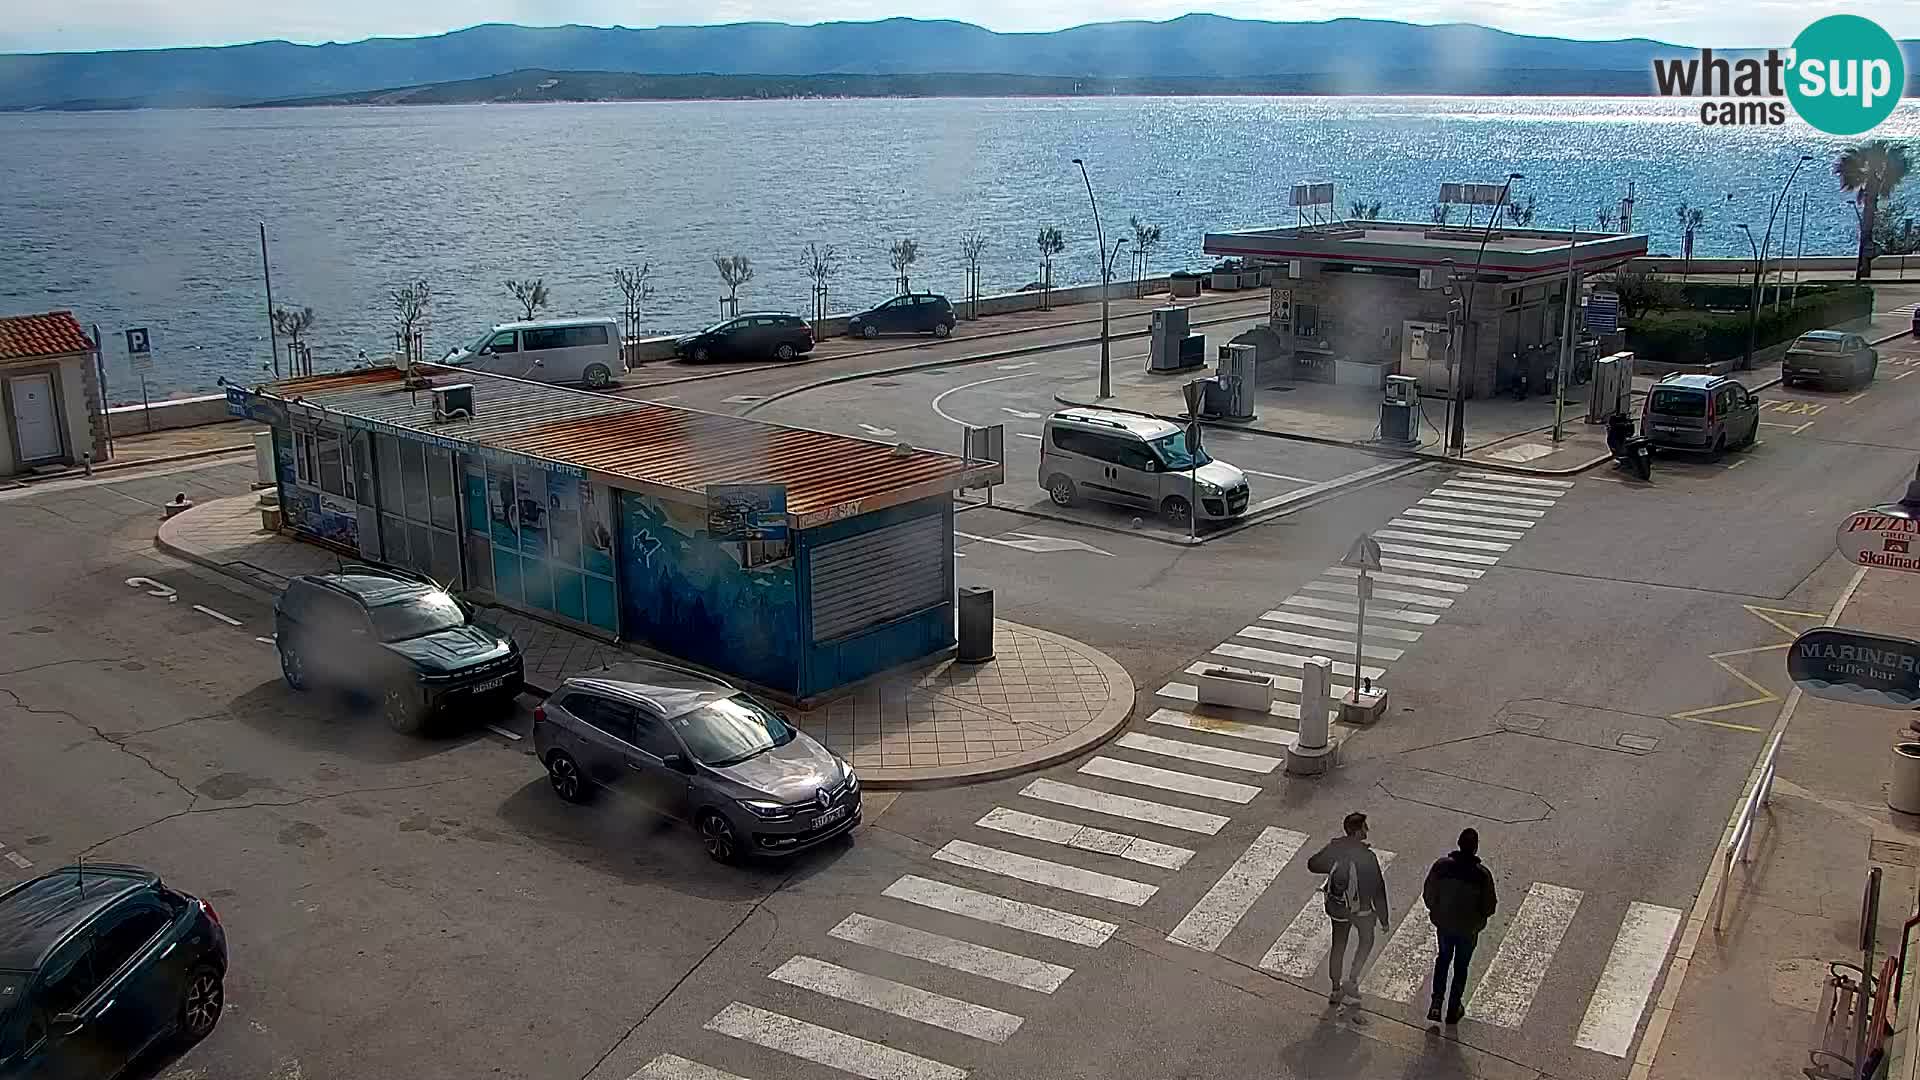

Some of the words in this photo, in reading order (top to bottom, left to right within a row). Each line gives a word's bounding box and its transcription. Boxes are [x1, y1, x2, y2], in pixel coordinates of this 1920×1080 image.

[131, 332, 144, 350] P
[1758, 400, 1827, 415] TAXI
[556, 463, 582, 478] OFFICE
[1847, 516, 1920, 535] PIZZE
[1799, 643, 1920, 673] MARINER
[1870, 667, 1896, 681] bar
